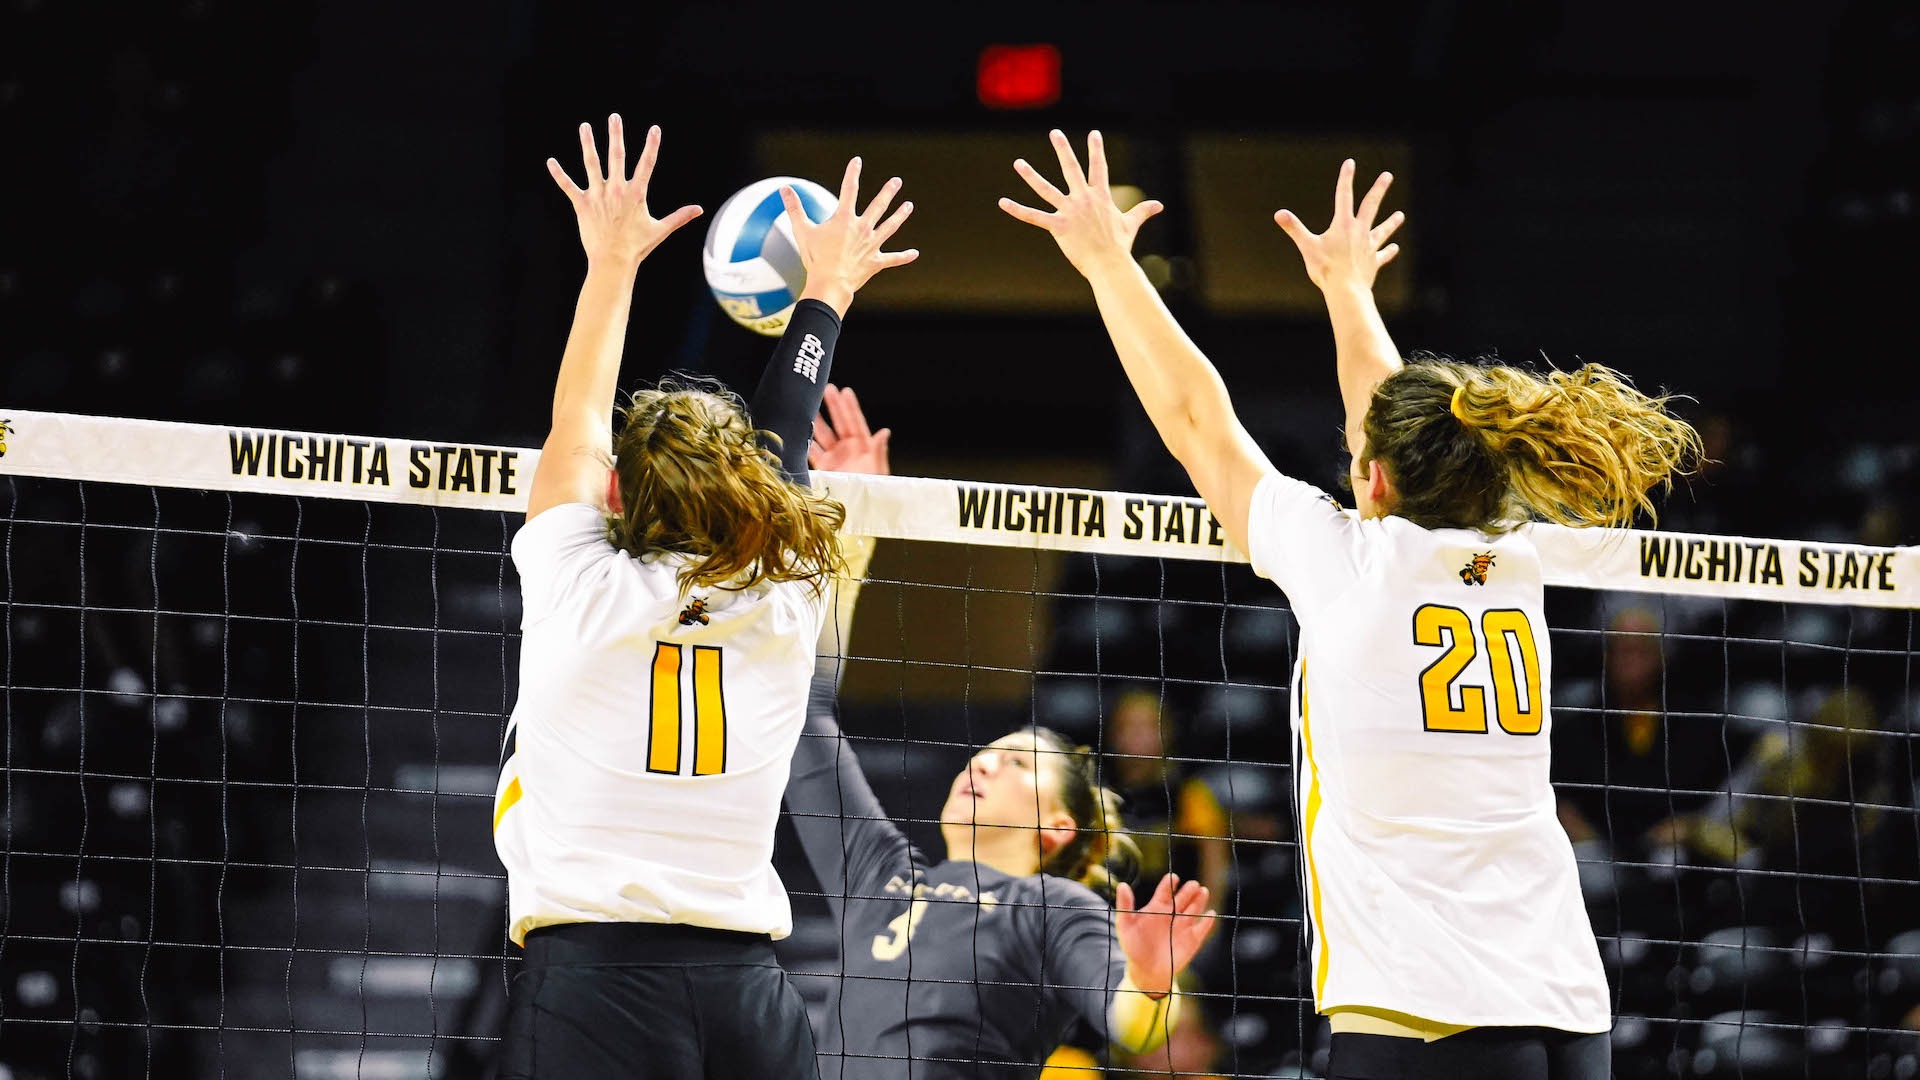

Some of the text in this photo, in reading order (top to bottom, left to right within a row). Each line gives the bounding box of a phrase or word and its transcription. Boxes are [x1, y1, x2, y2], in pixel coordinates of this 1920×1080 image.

[229, 429, 518, 495] WICHITA STATE
[957, 486, 1105, 538] WICHITA
[1640, 536, 1896, 591] WICHITA STATE
[1412, 602, 1543, 736] 20
[646, 640, 727, 776] 11
